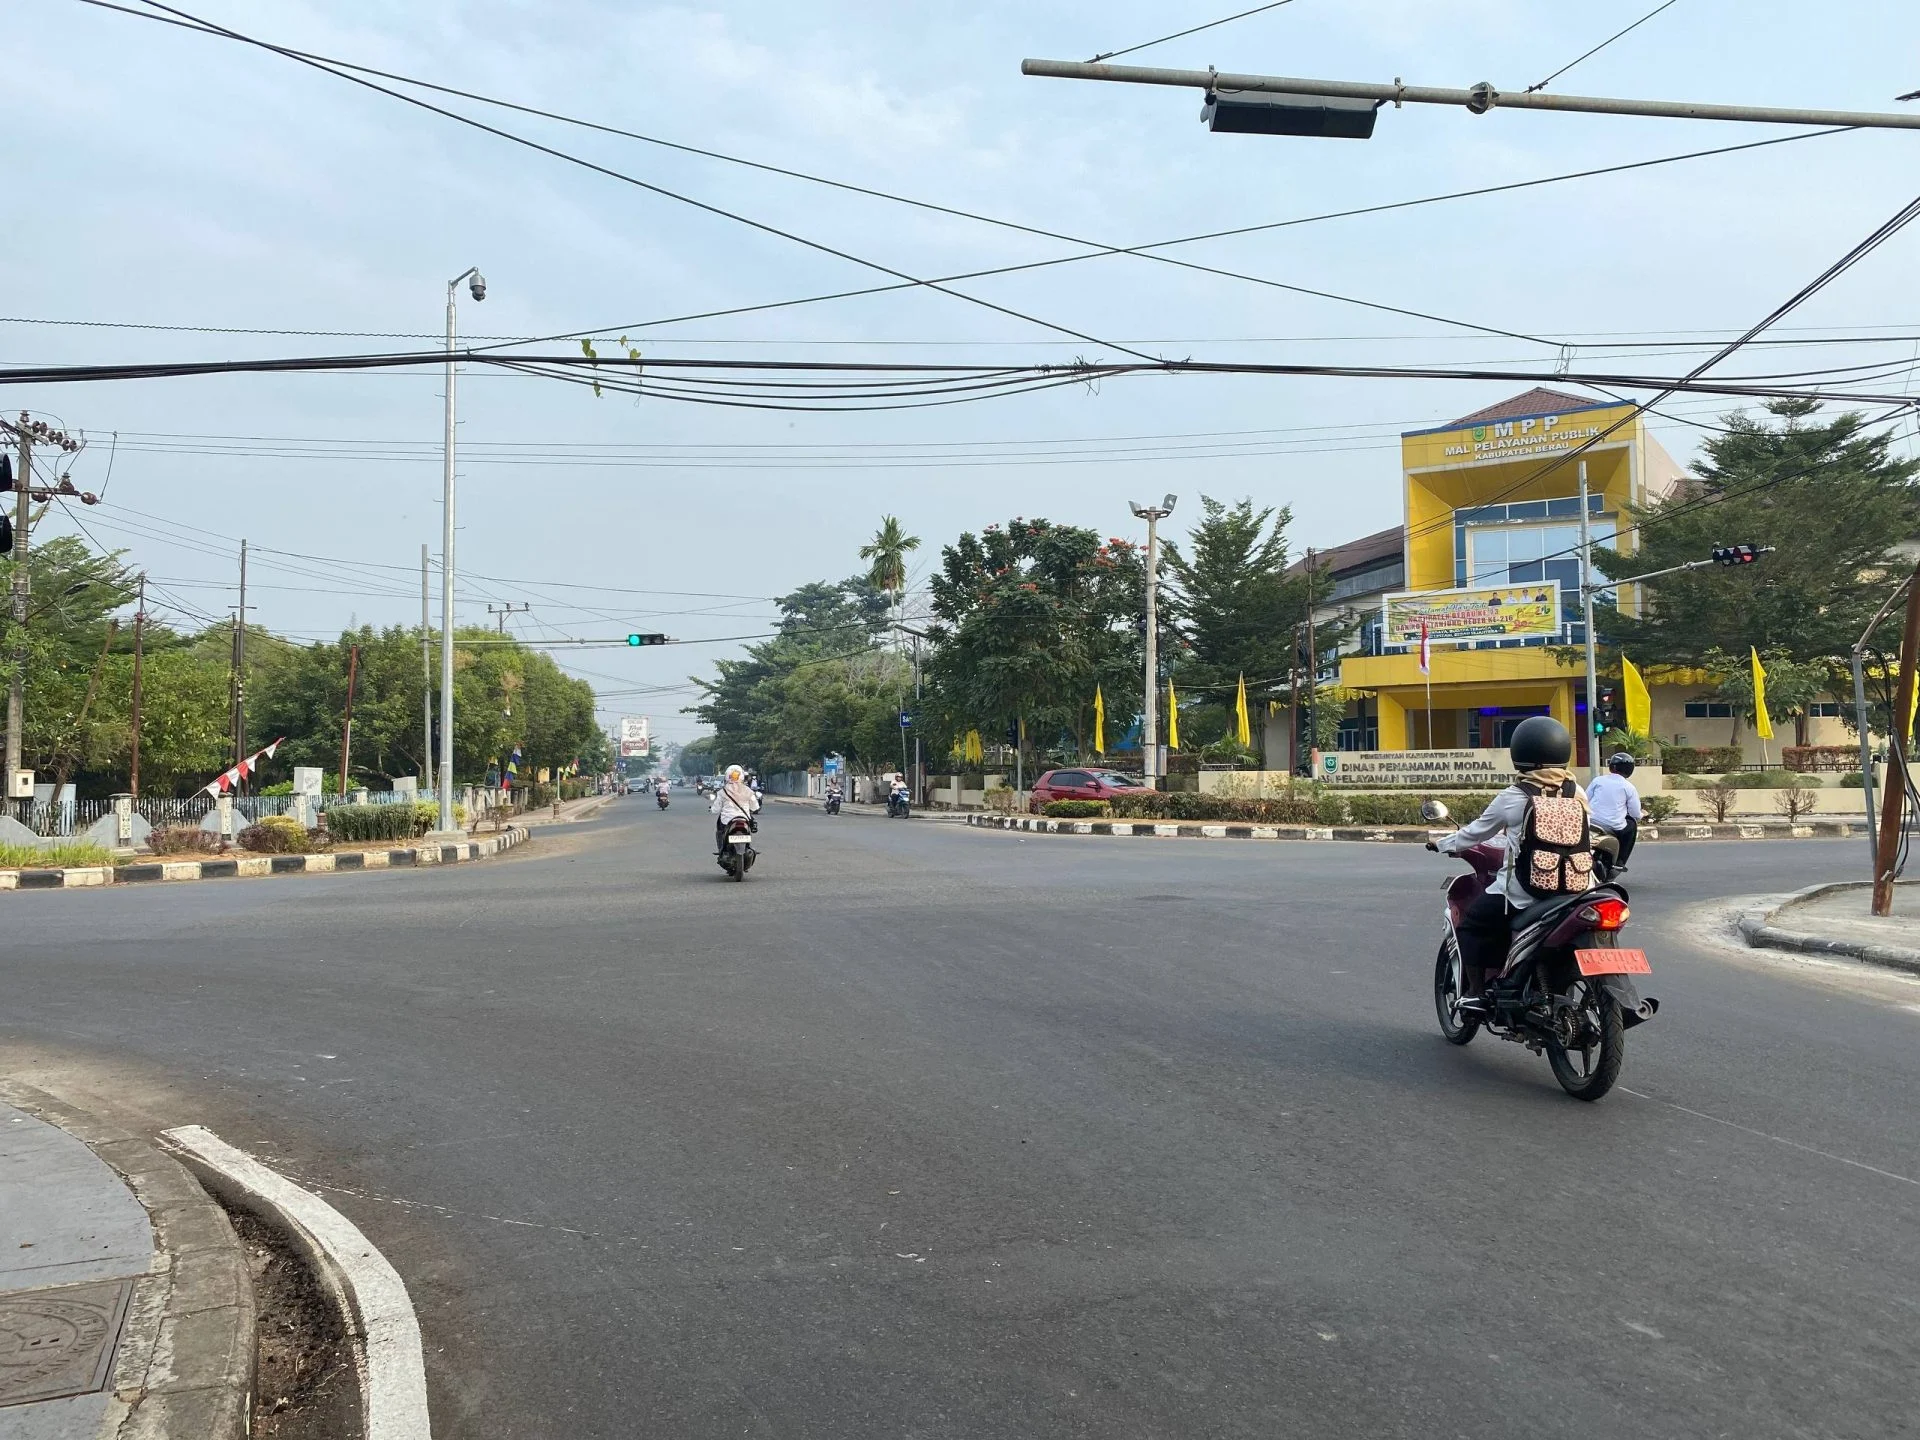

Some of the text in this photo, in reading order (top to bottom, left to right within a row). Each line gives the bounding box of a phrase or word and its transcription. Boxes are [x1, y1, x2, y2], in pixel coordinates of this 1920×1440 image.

[1495, 415, 1559, 438] MPP
[1445, 427, 1600, 456] MAL PELAYANAN PUBLIK
[1475, 441, 1569, 460] KABUPATEN BERAU
[1341, 761, 1496, 773] DINAS PENANAMAN MODAL
[1335, 774, 1400, 784] PELAYANAN
[1402, 773, 1454, 783] TERPADU
[1457, 773, 1488, 783] SATU
